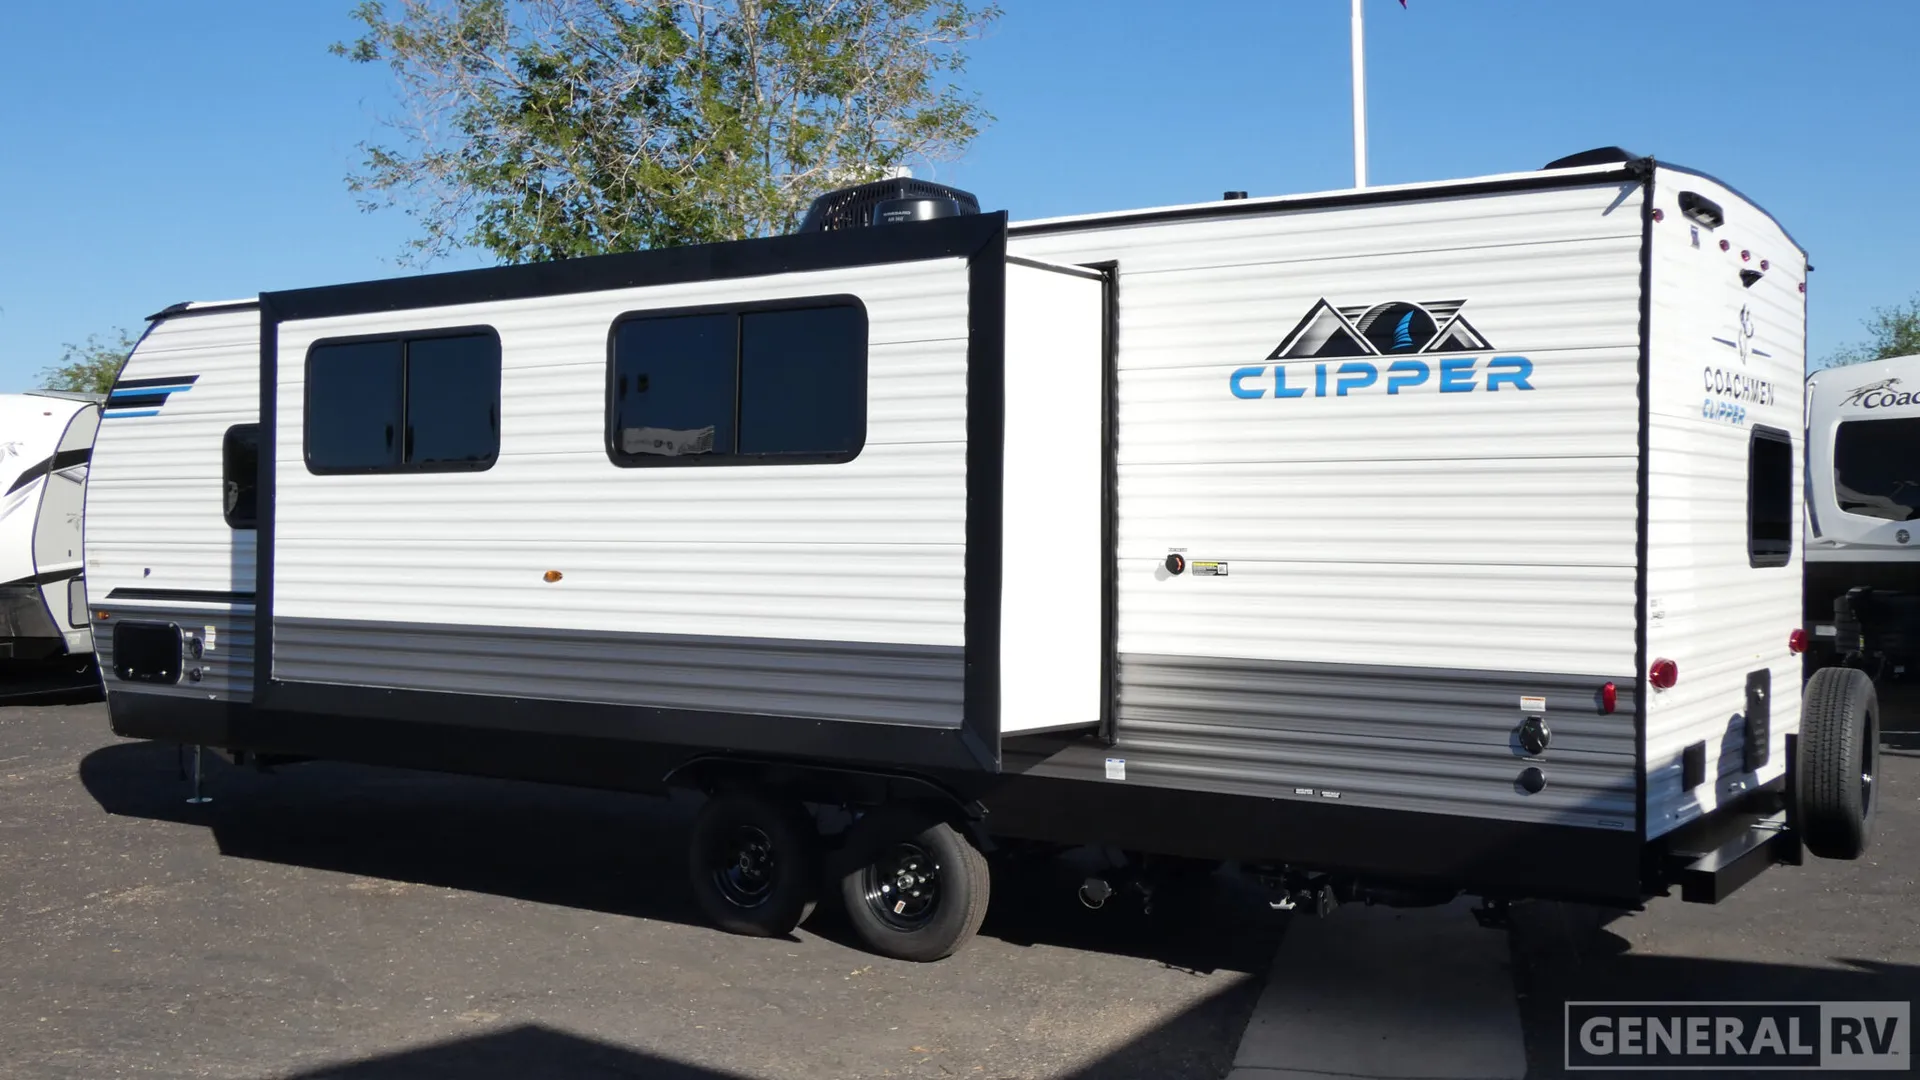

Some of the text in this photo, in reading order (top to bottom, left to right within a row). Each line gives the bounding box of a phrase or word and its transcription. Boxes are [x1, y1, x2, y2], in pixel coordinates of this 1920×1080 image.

[1229, 355, 1536, 400] CLIPPER
[1703, 366, 1775, 406] COACHMEN
[1702, 398, 1746, 425] CLIPPER
